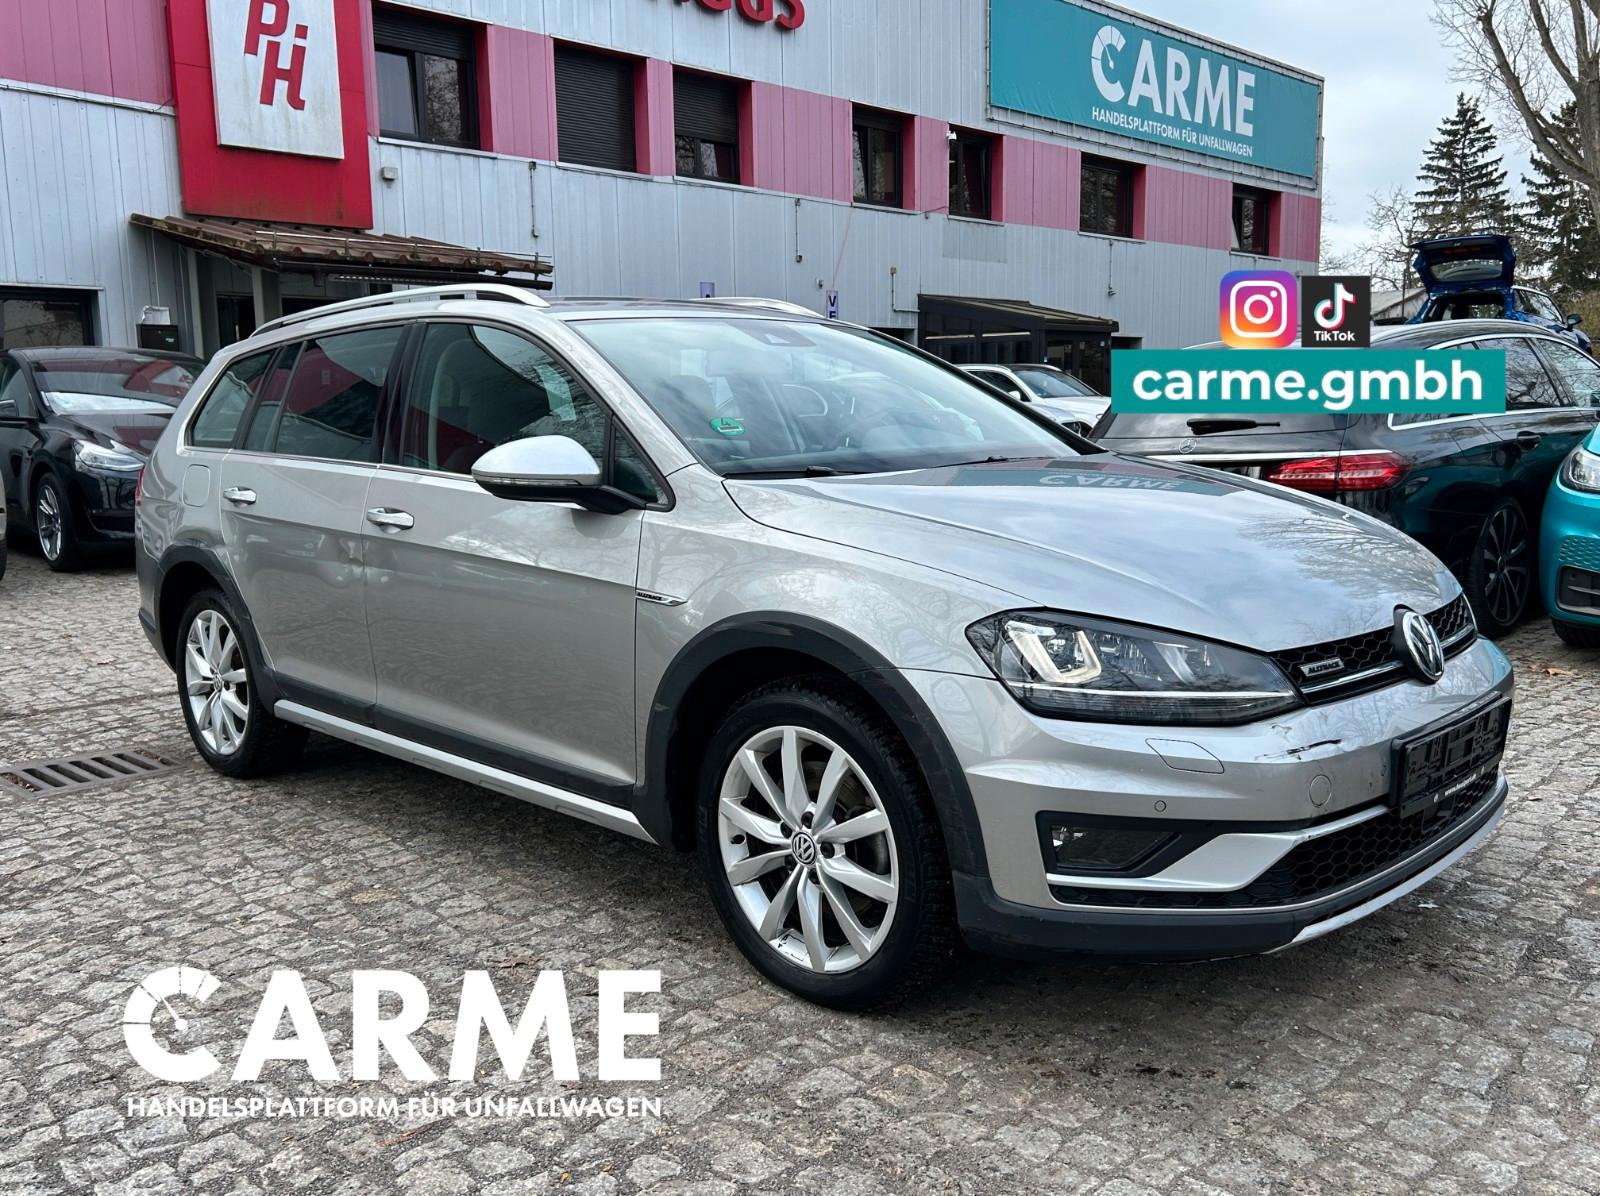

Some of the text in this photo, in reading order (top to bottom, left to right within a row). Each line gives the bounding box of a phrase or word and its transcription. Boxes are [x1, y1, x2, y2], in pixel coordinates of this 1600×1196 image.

[1091, 25, 1256, 137] CARME
[1091, 106, 1253, 157] HANDELSPLATTFORM FÜR UNFALLWAGEN
